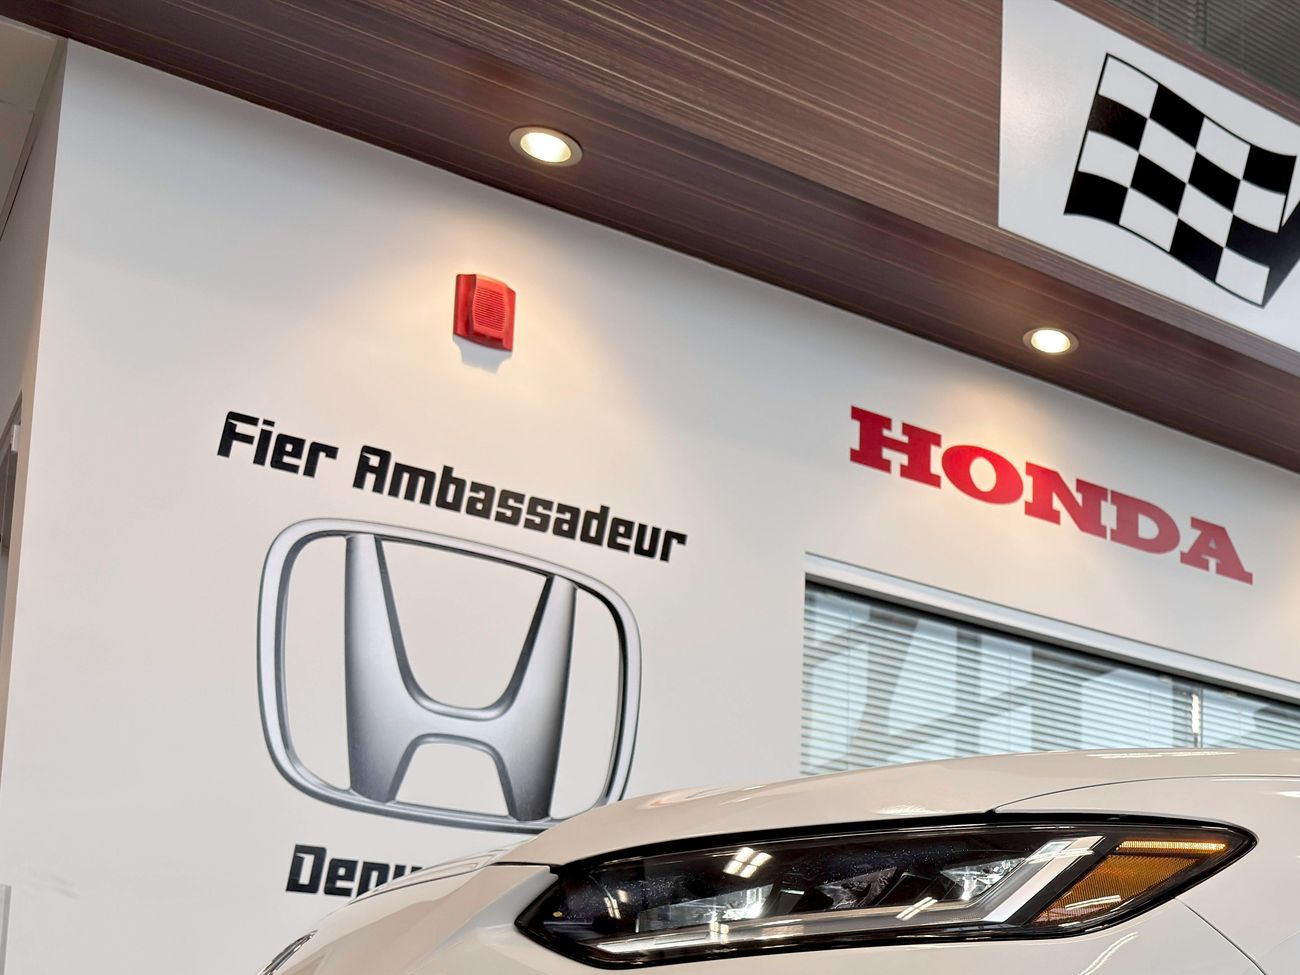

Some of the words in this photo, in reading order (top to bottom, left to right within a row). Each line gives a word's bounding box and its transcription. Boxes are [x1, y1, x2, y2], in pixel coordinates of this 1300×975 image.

[217, 411, 339, 478] Fier
[352, 445, 688, 562] Ambassadeur
[850, 405, 1253, 585] HONDA
[286, 843, 423, 898] Dep
